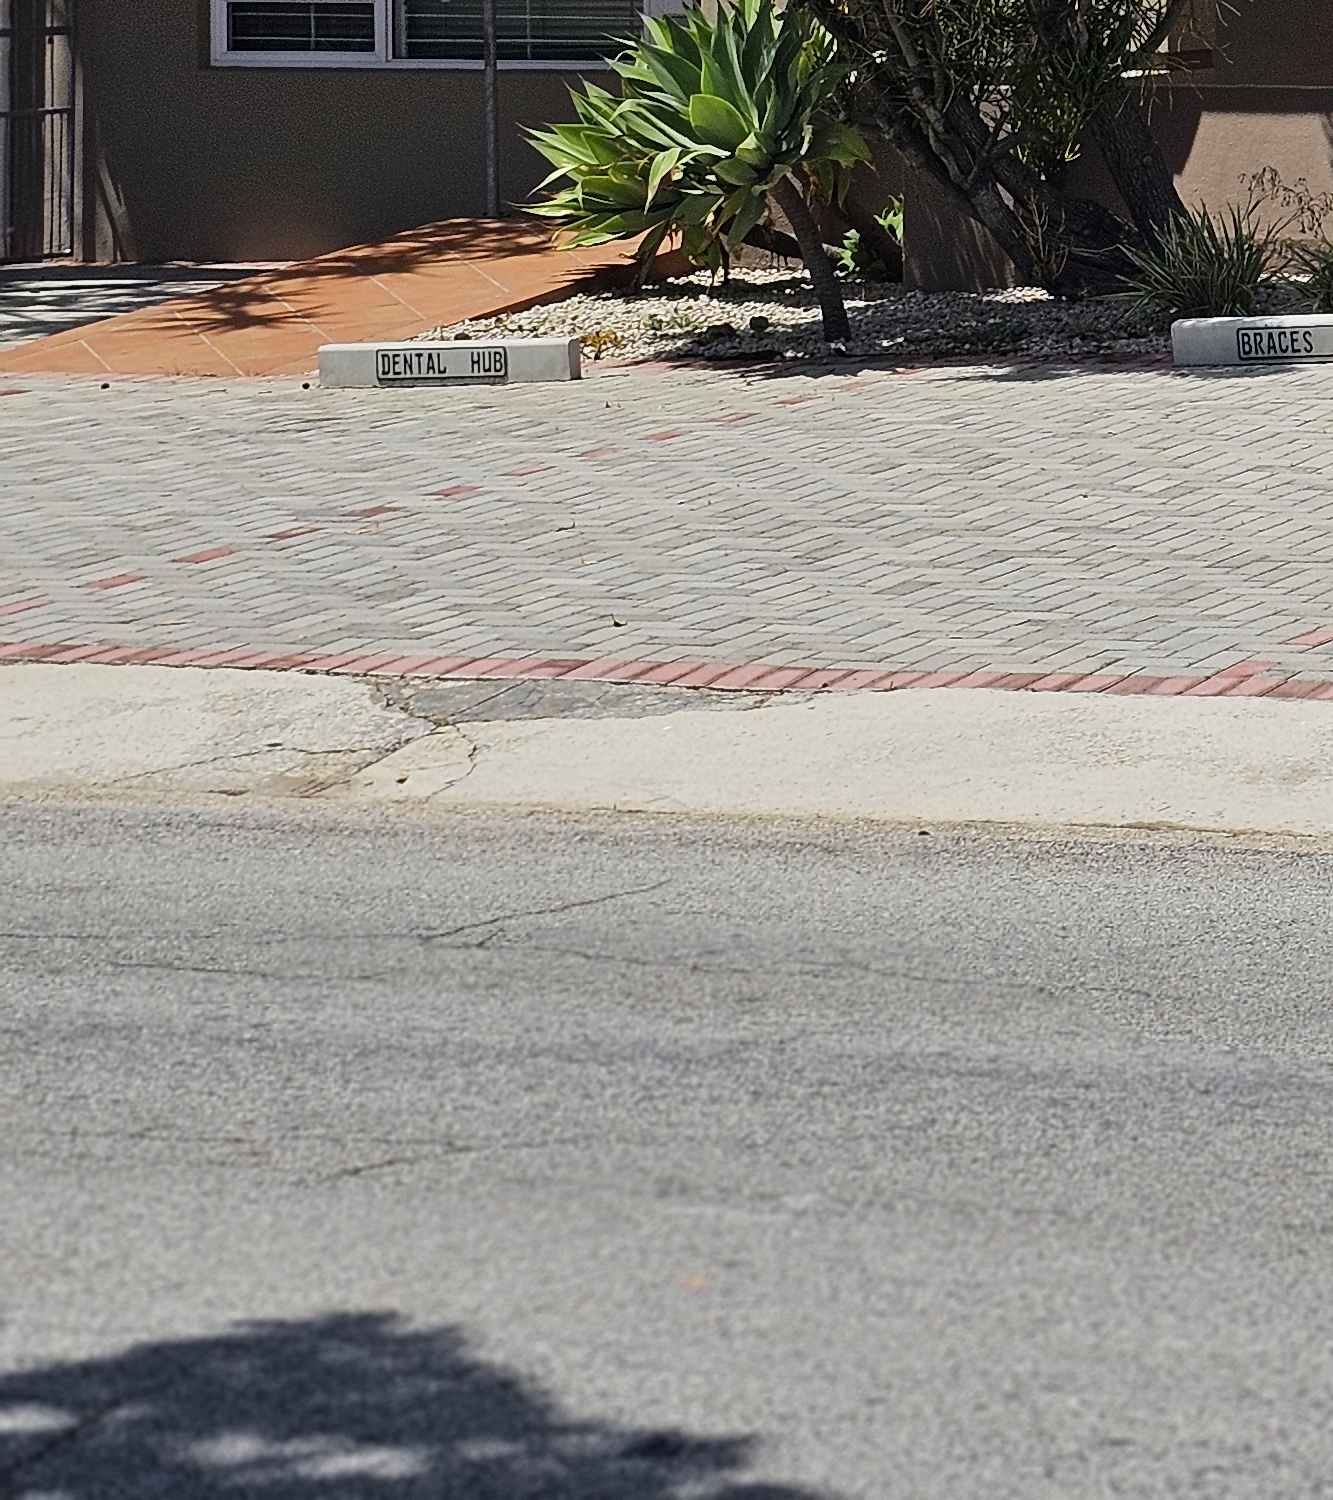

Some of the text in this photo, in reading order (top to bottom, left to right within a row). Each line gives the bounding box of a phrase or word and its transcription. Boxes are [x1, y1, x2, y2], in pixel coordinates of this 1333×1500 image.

[1241, 330, 1314, 356] BRACES
[380, 351, 503, 376] DENTAL HUB
